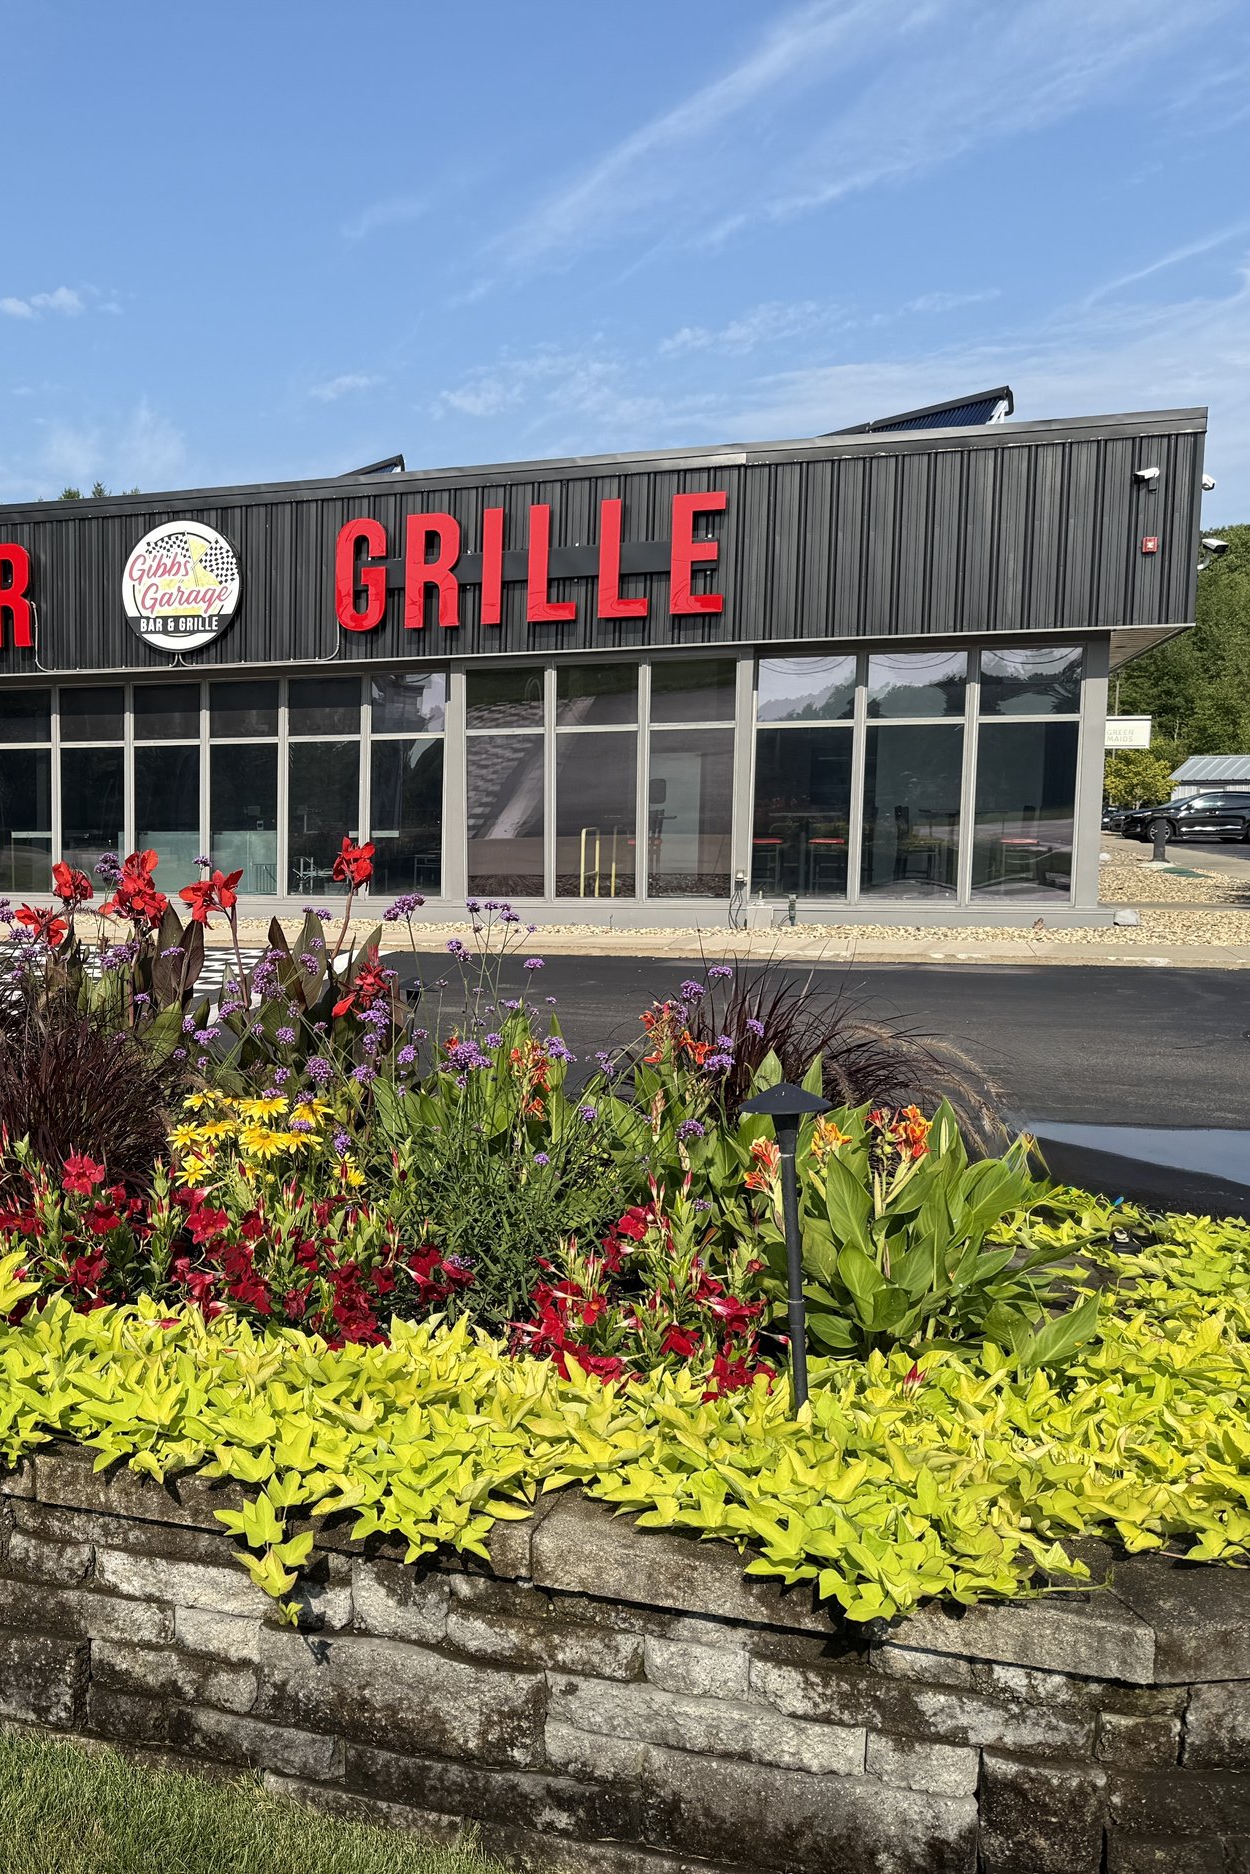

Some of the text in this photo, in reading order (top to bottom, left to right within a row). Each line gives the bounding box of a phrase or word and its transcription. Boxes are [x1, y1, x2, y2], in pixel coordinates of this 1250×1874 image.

[335, 491, 727, 632] GRILLE
[140, 582, 232, 615] Garage
[140, 616, 219, 632] BAR & GRILLE
